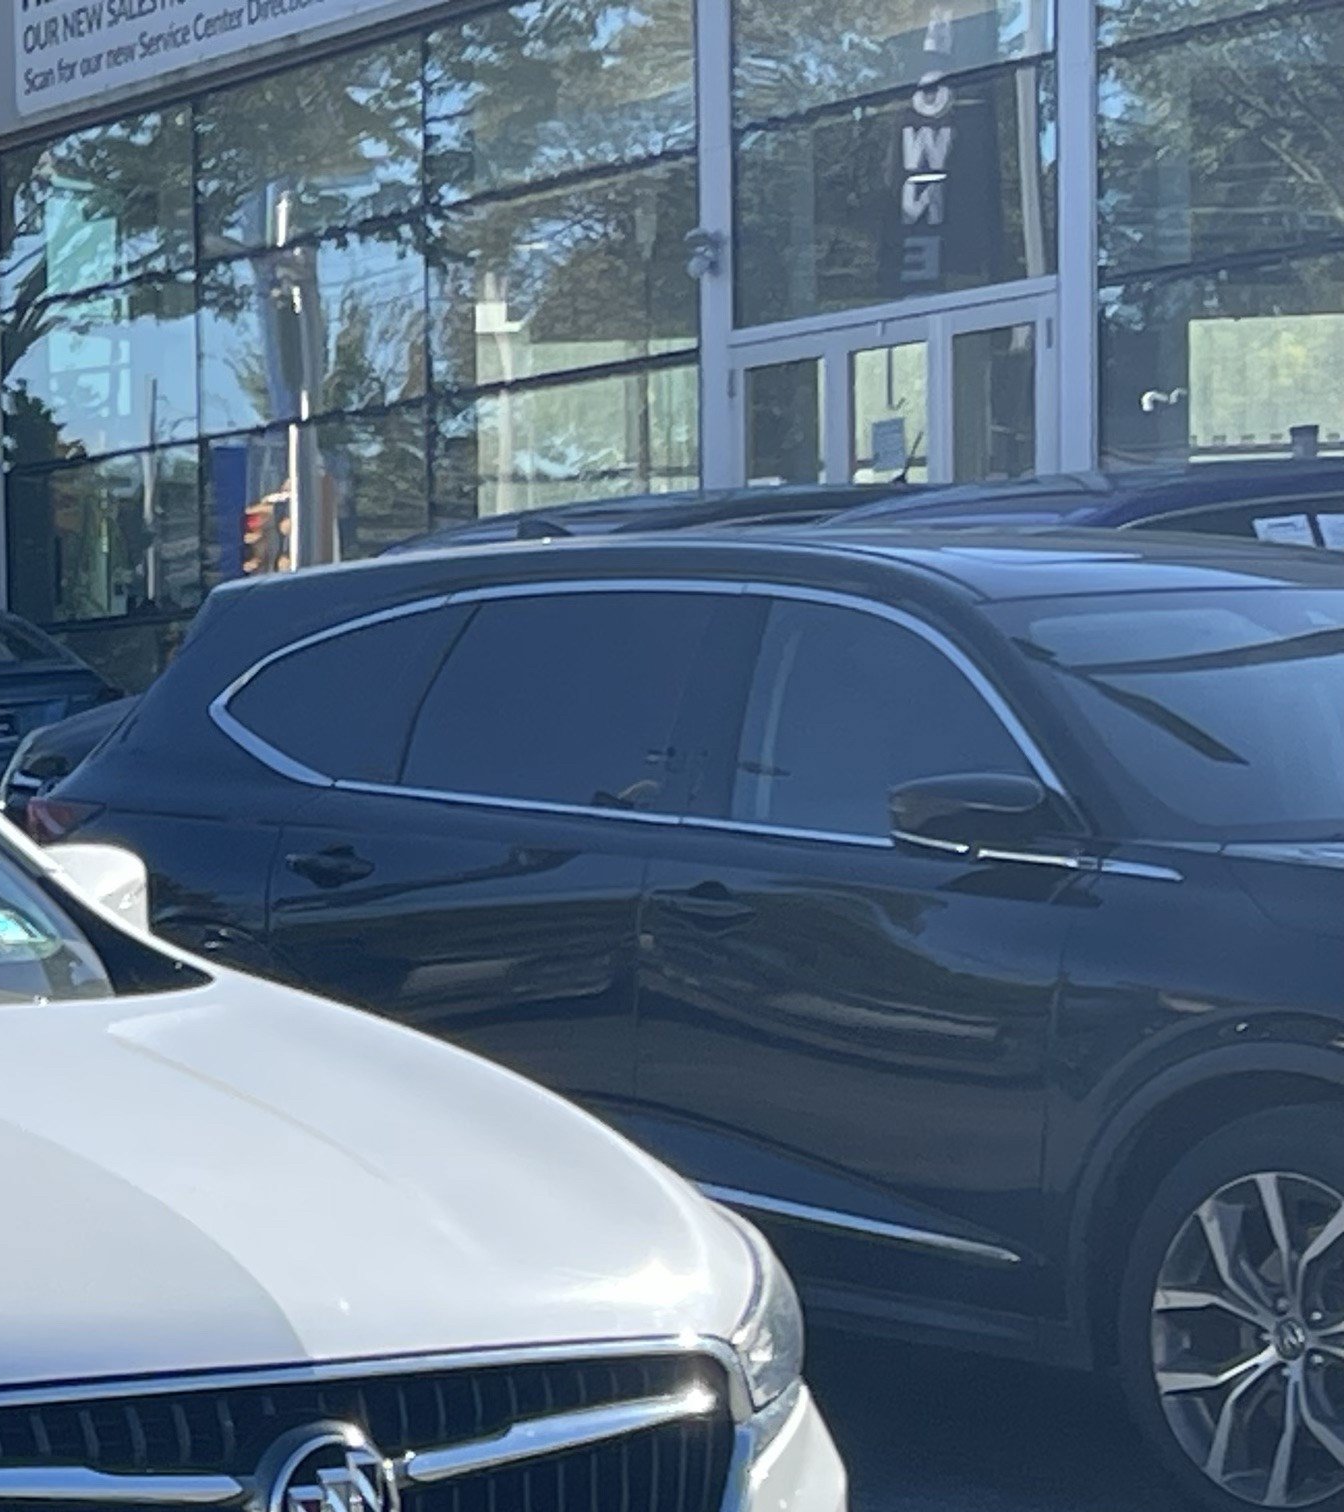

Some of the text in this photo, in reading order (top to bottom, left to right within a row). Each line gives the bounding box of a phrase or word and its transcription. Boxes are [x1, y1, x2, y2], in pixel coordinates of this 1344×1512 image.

[24, 17, 60, 54] OUR
[62, 3, 104, 41] NEW
[24, 67, 56, 96] Scan
[57, 58, 78, 83] for
[80, 53, 103, 78] our
[107, 43, 137, 69] new
[138, 21, 191, 58] Service
[193, 7, 243, 41] Center
